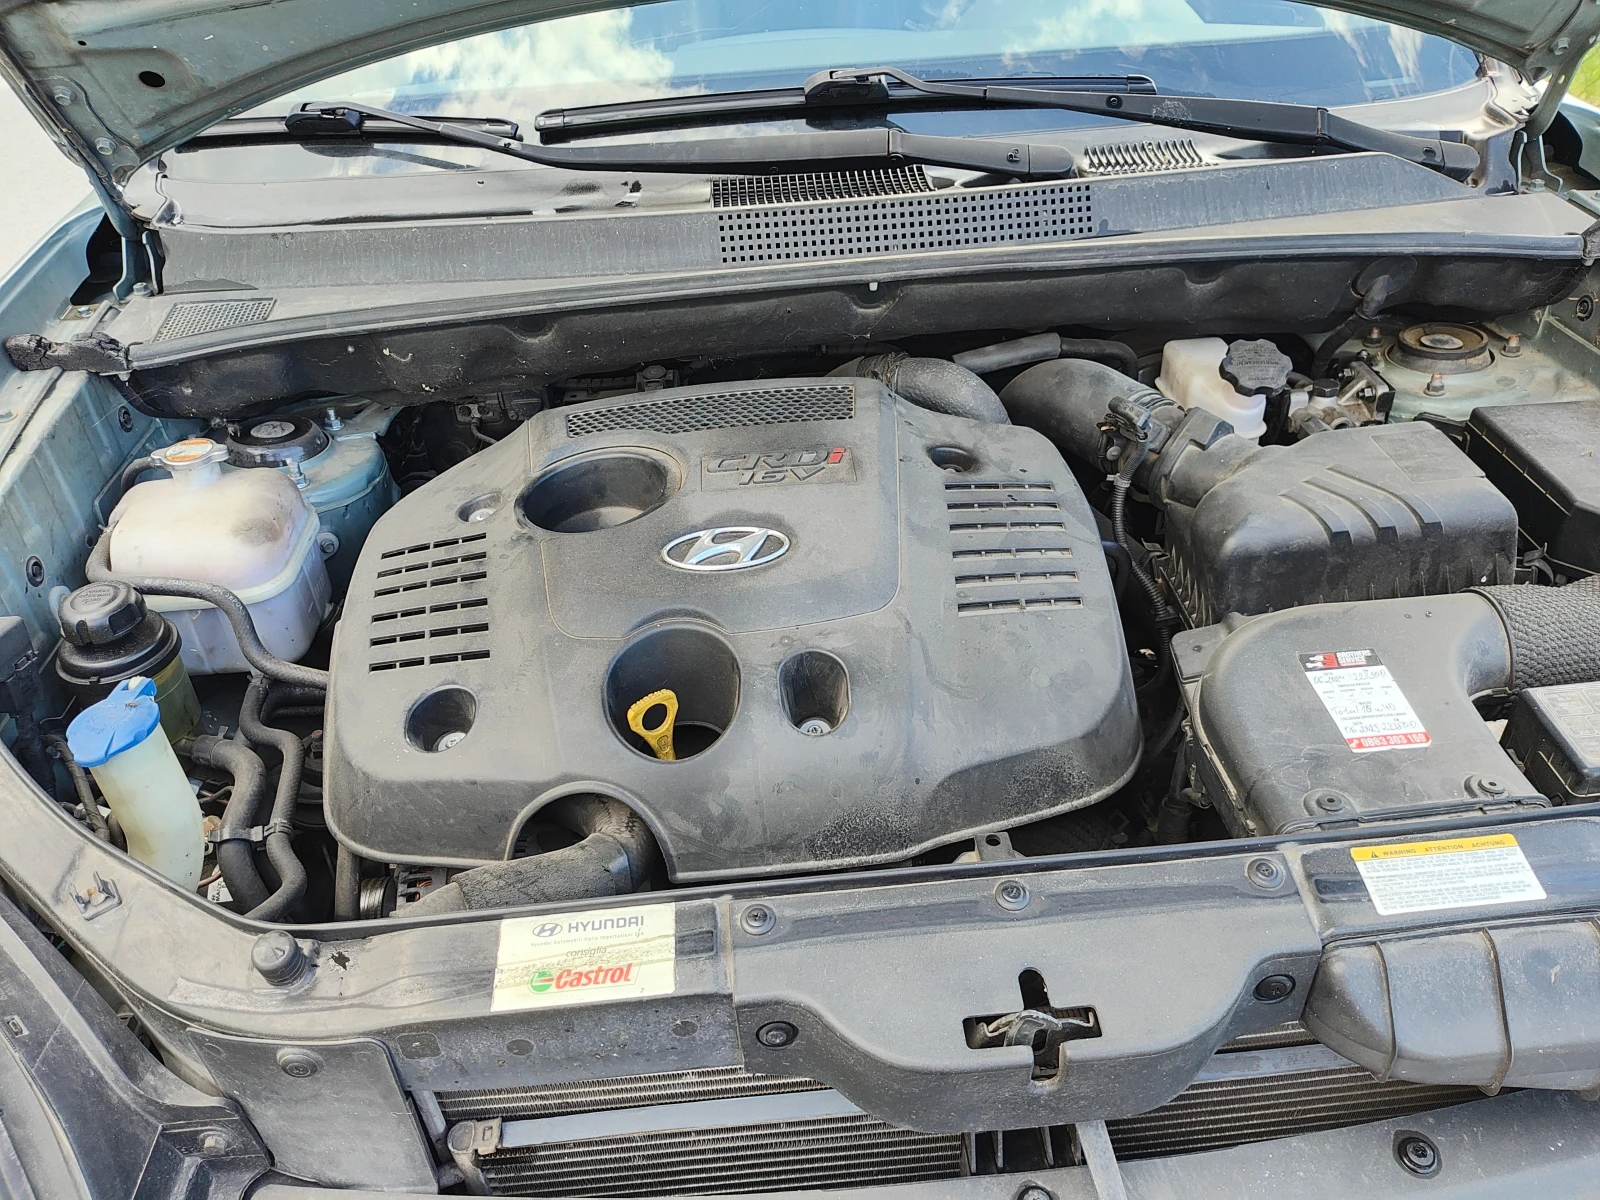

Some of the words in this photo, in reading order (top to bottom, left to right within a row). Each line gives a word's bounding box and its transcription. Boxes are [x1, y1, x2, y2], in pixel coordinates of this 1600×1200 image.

[707, 447, 846, 473] CRDi
[739, 466, 826, 486] 16V
[1386, 735, 1408, 745] 303
[1382, 848, 1417, 856] WARNING
[1424, 844, 1464, 853] ATTENTION
[1471, 839, 1506, 848] ACHTUNG
[568, 915, 645, 933] HYUNDAI
[565, 945, 607, 958] consiglia
[555, 963, 633, 990] Castrol
